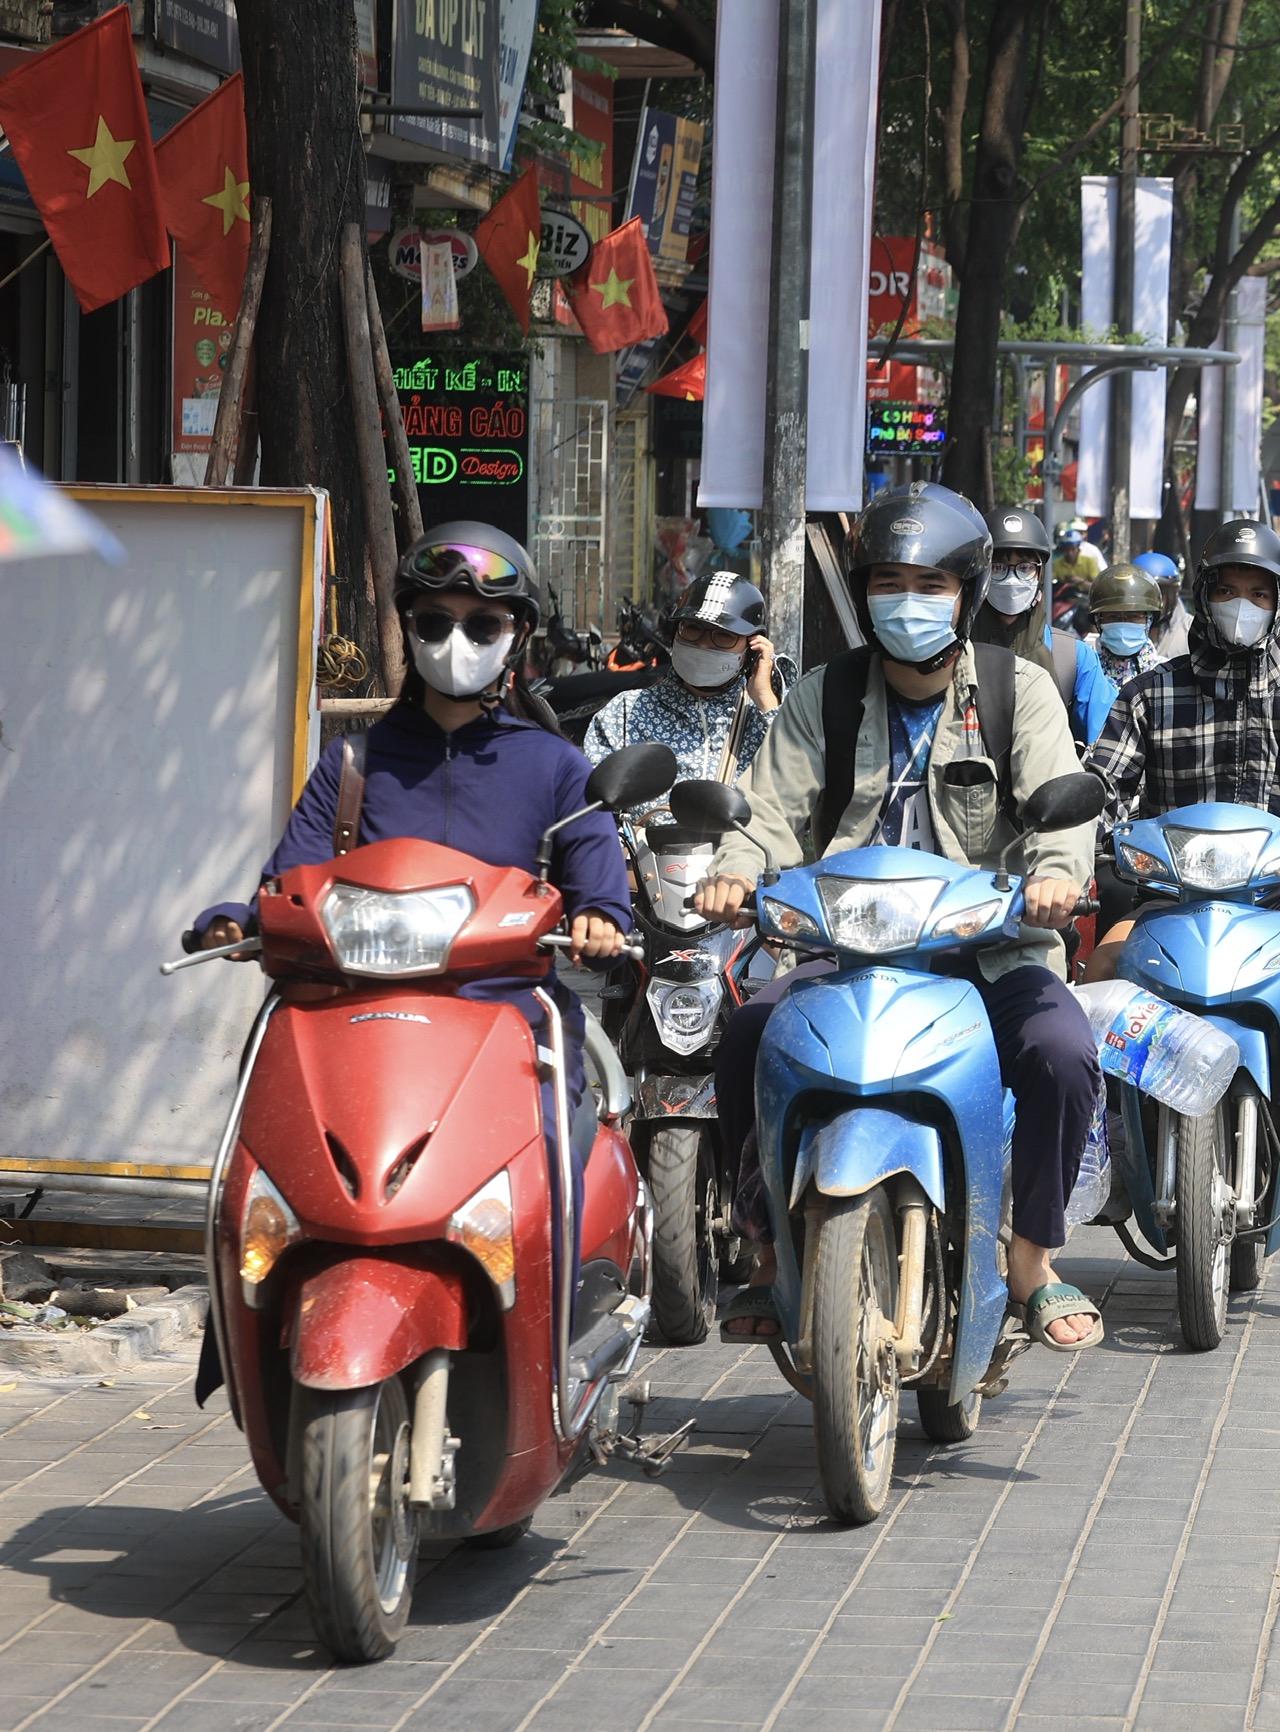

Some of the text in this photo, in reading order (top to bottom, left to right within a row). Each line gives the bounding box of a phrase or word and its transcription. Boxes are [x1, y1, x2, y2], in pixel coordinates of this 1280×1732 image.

[392, 357, 439, 390] HIẾT
[470, 401, 524, 438] CÁO
[461, 456, 519, 480] Design
[1192, 906, 1233, 915] HONDA
[850, 973, 900, 984] HONDA
[349, 1011, 432, 1024] HONDA
